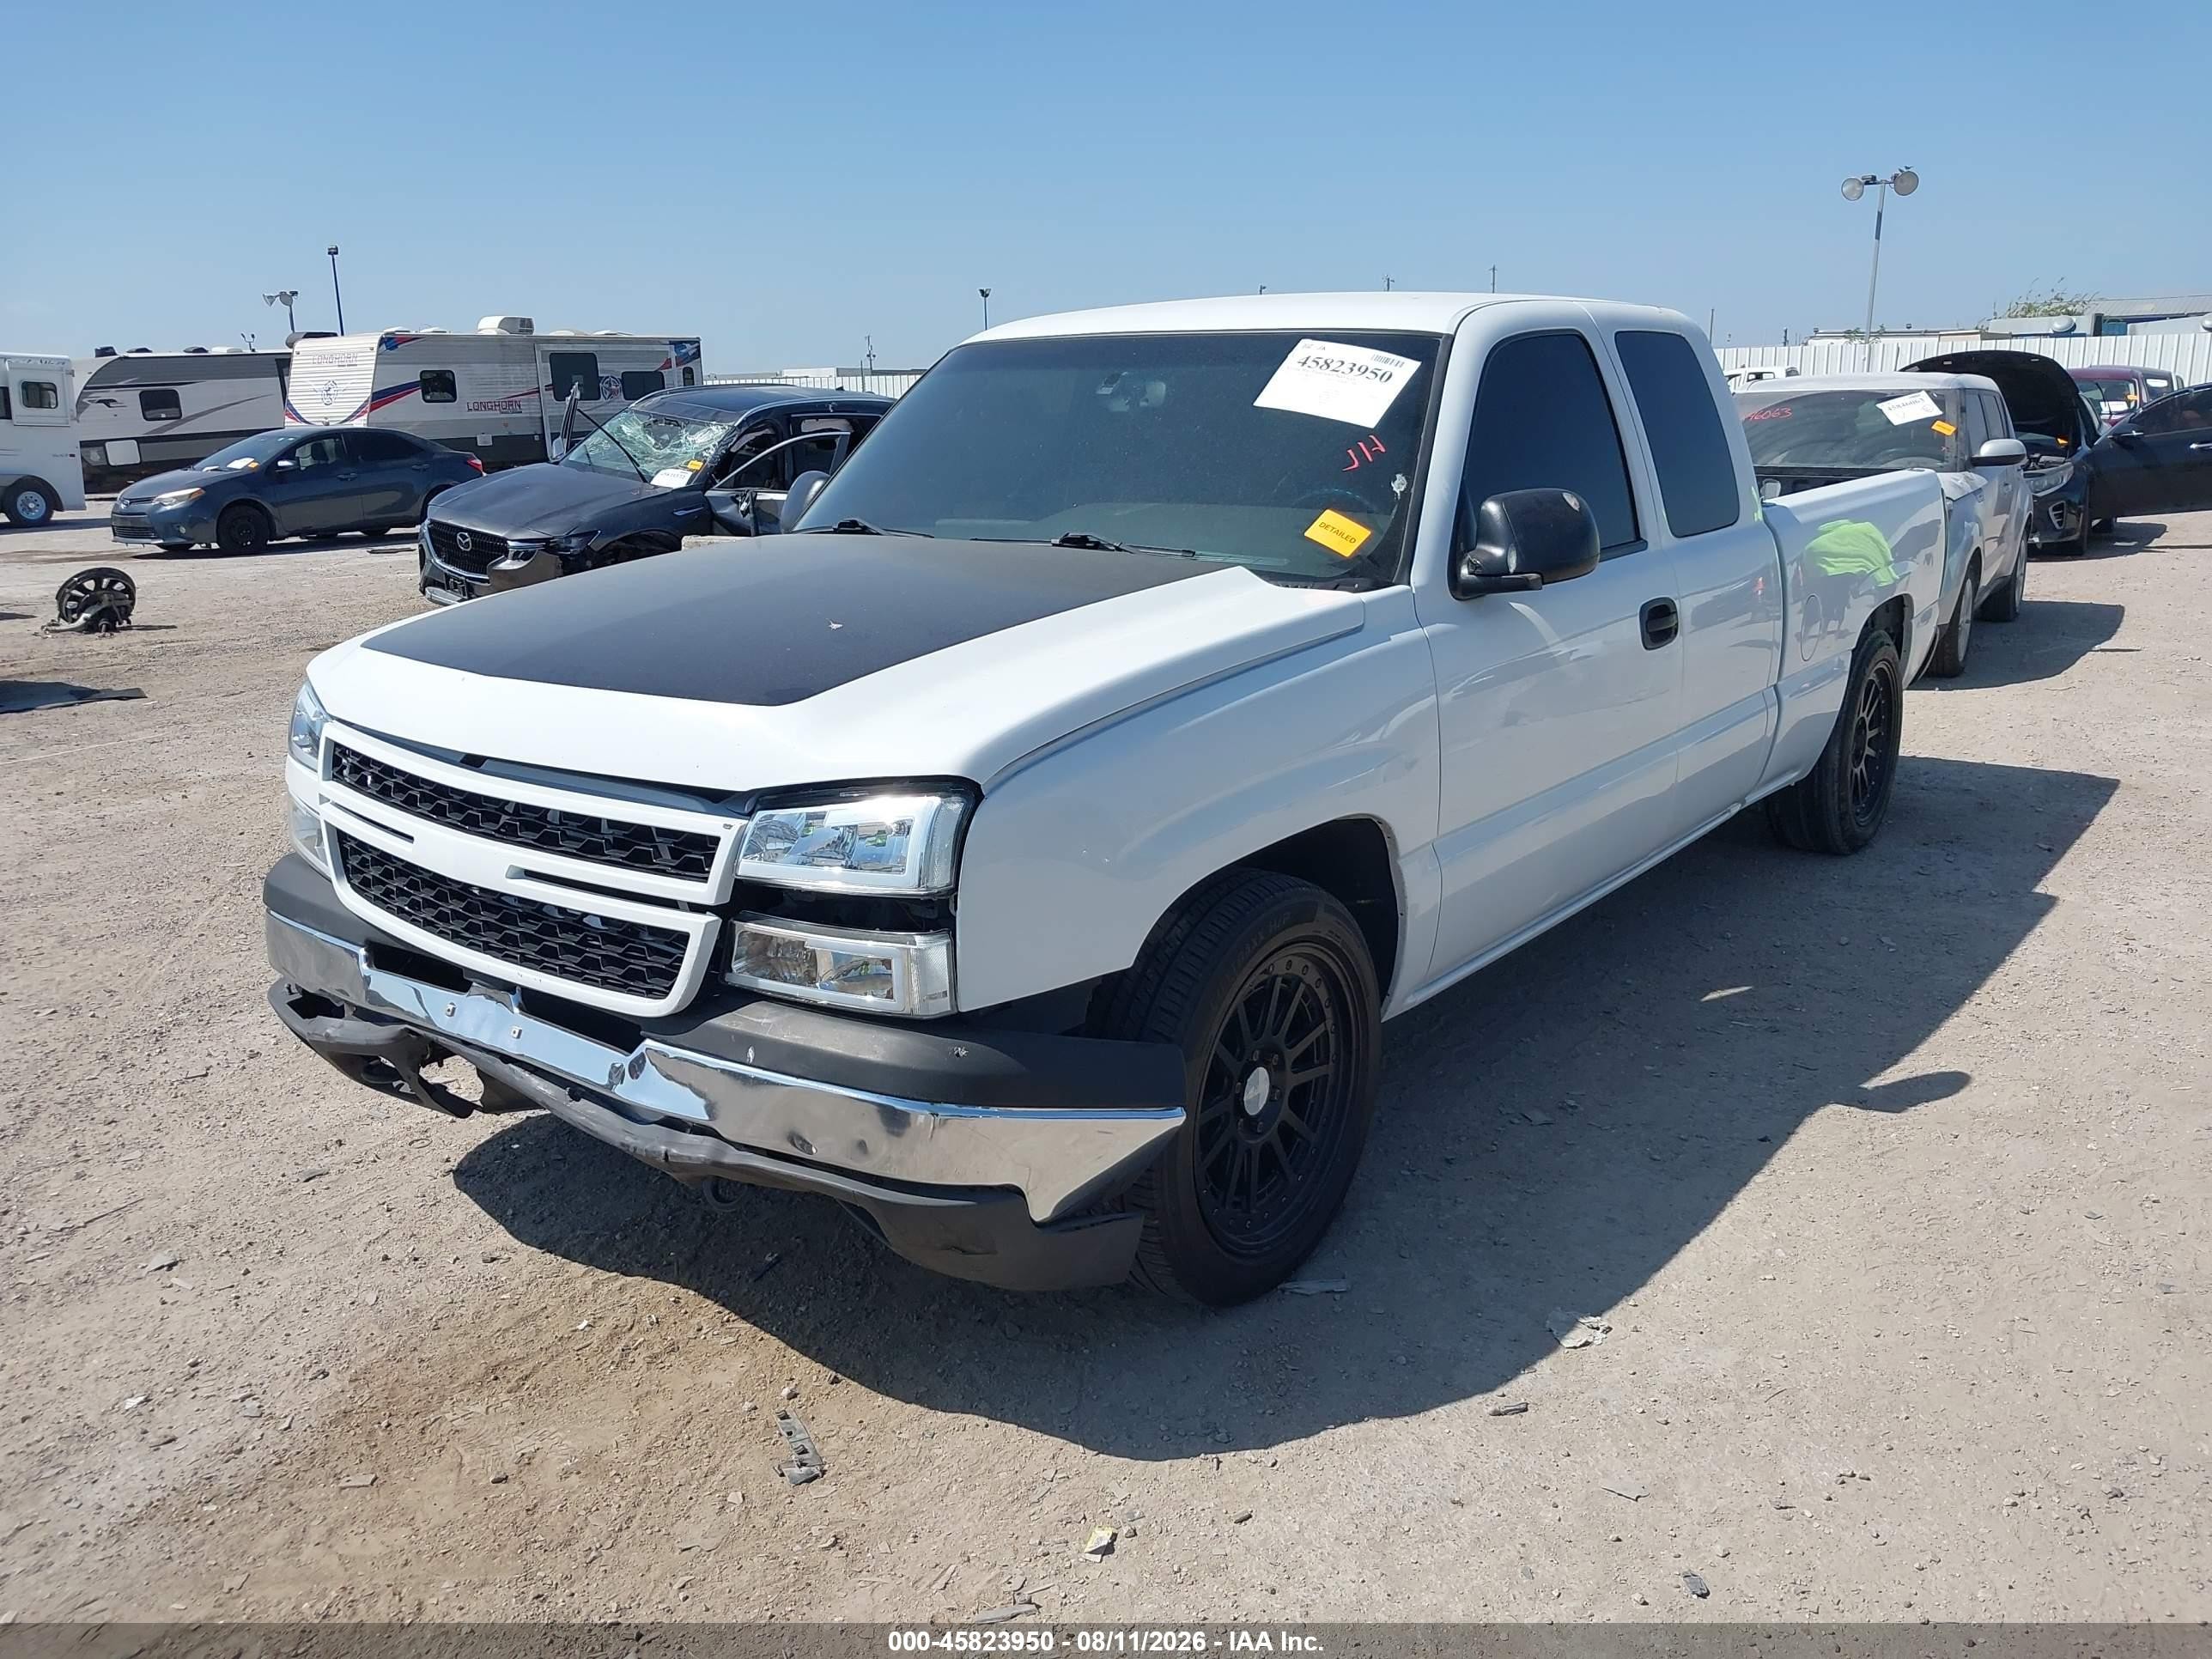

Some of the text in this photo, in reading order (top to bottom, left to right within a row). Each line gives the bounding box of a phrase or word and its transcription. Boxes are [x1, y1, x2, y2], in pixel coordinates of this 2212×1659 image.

[313, 352, 358, 365] LONGHORN
[1297, 355, 1393, 383] 45823950
[466, 400, 522, 412] LONGHORN
[1318, 521, 1357, 544] DETAILED
